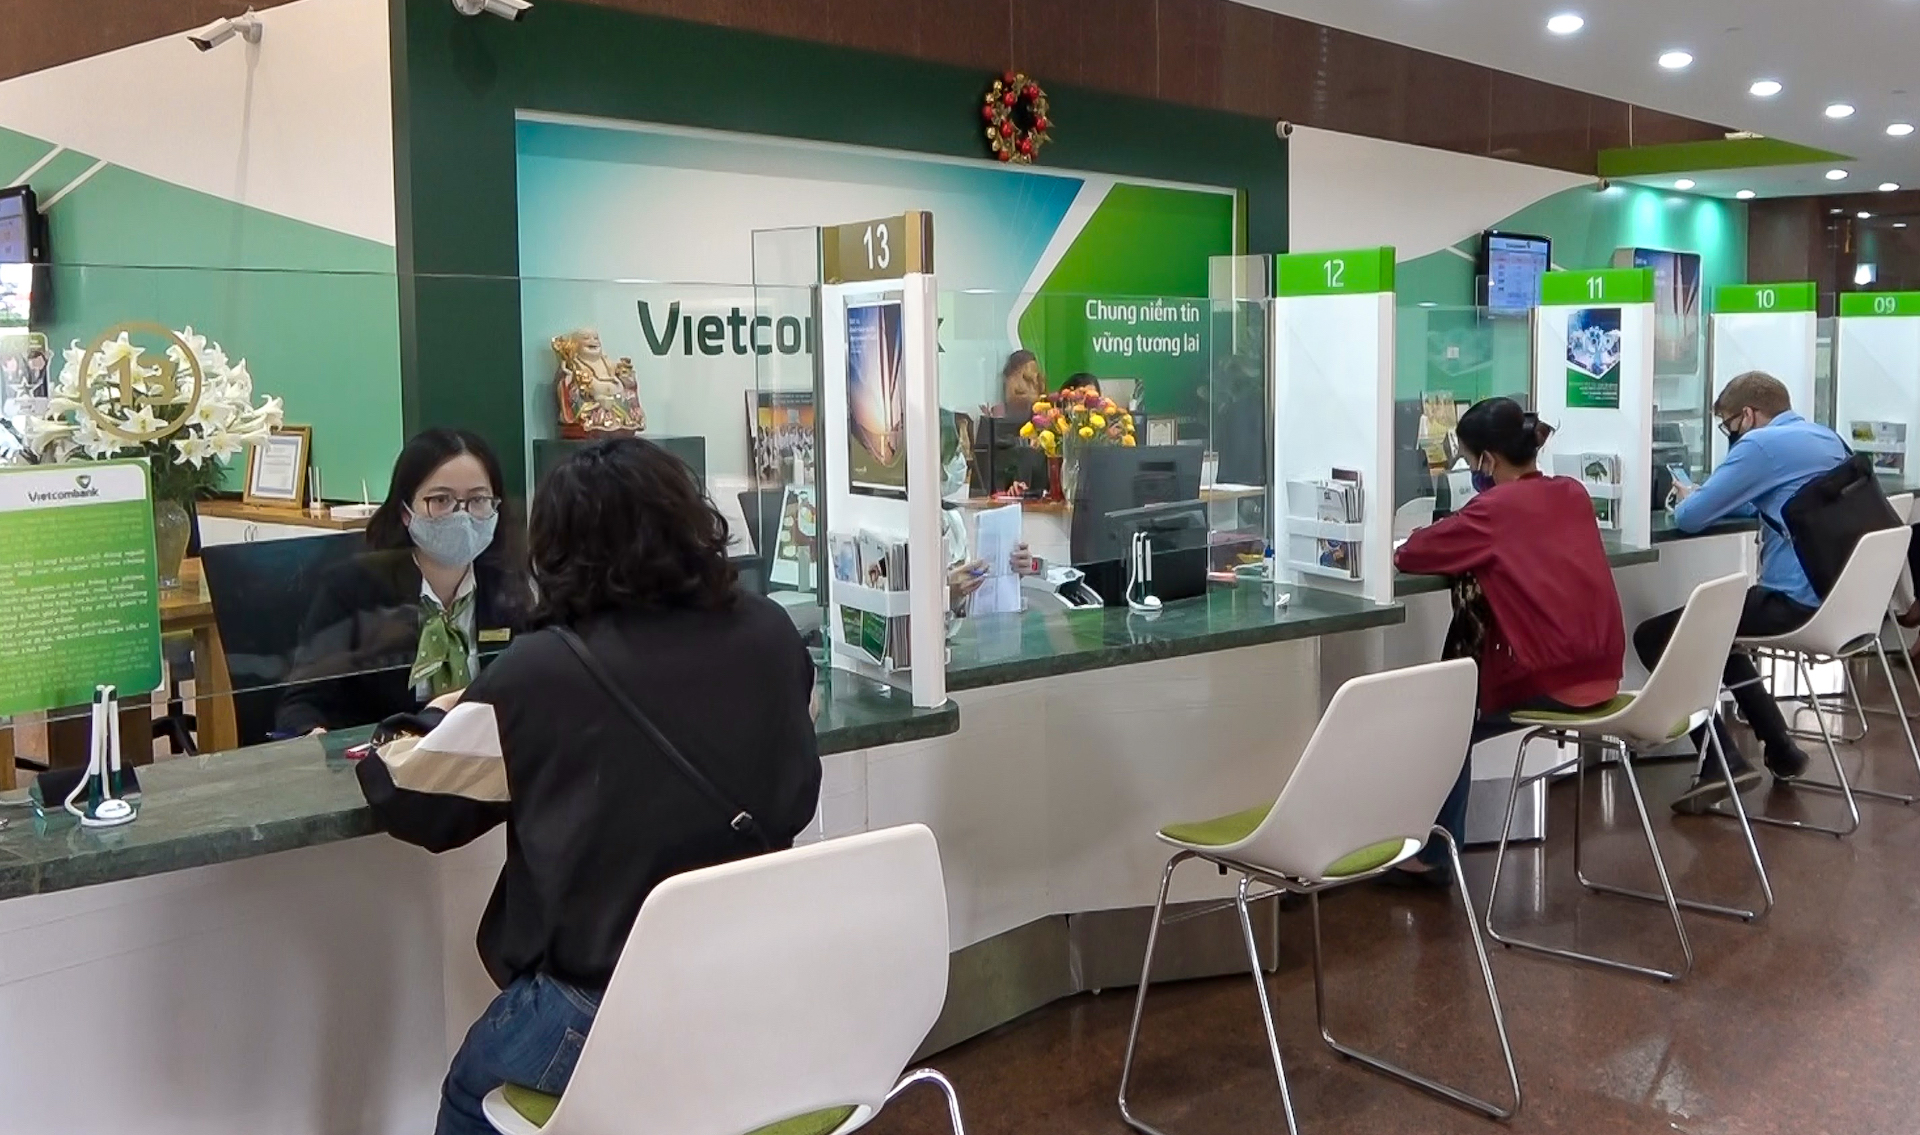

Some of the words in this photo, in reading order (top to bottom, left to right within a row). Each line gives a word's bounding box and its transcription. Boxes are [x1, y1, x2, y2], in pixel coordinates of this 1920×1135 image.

[863, 223, 890, 270] 13
[1323, 259, 1345, 288] 12
[1586, 276, 1603, 299] 11
[1756, 289, 1775, 309] 10
[1085, 299, 1137, 325] Chung
[1140, 297, 1178, 322] niềm
[1180, 302, 1201, 322] tin
[1874, 296, 1896, 315] 09
[637, 299, 946, 356] Vietco
[1092, 331, 1133, 357] vững
[1136, 334, 1181, 357] tương
[1183, 332, 1201, 353] lai
[28, 487, 100, 502] Vietcombank
